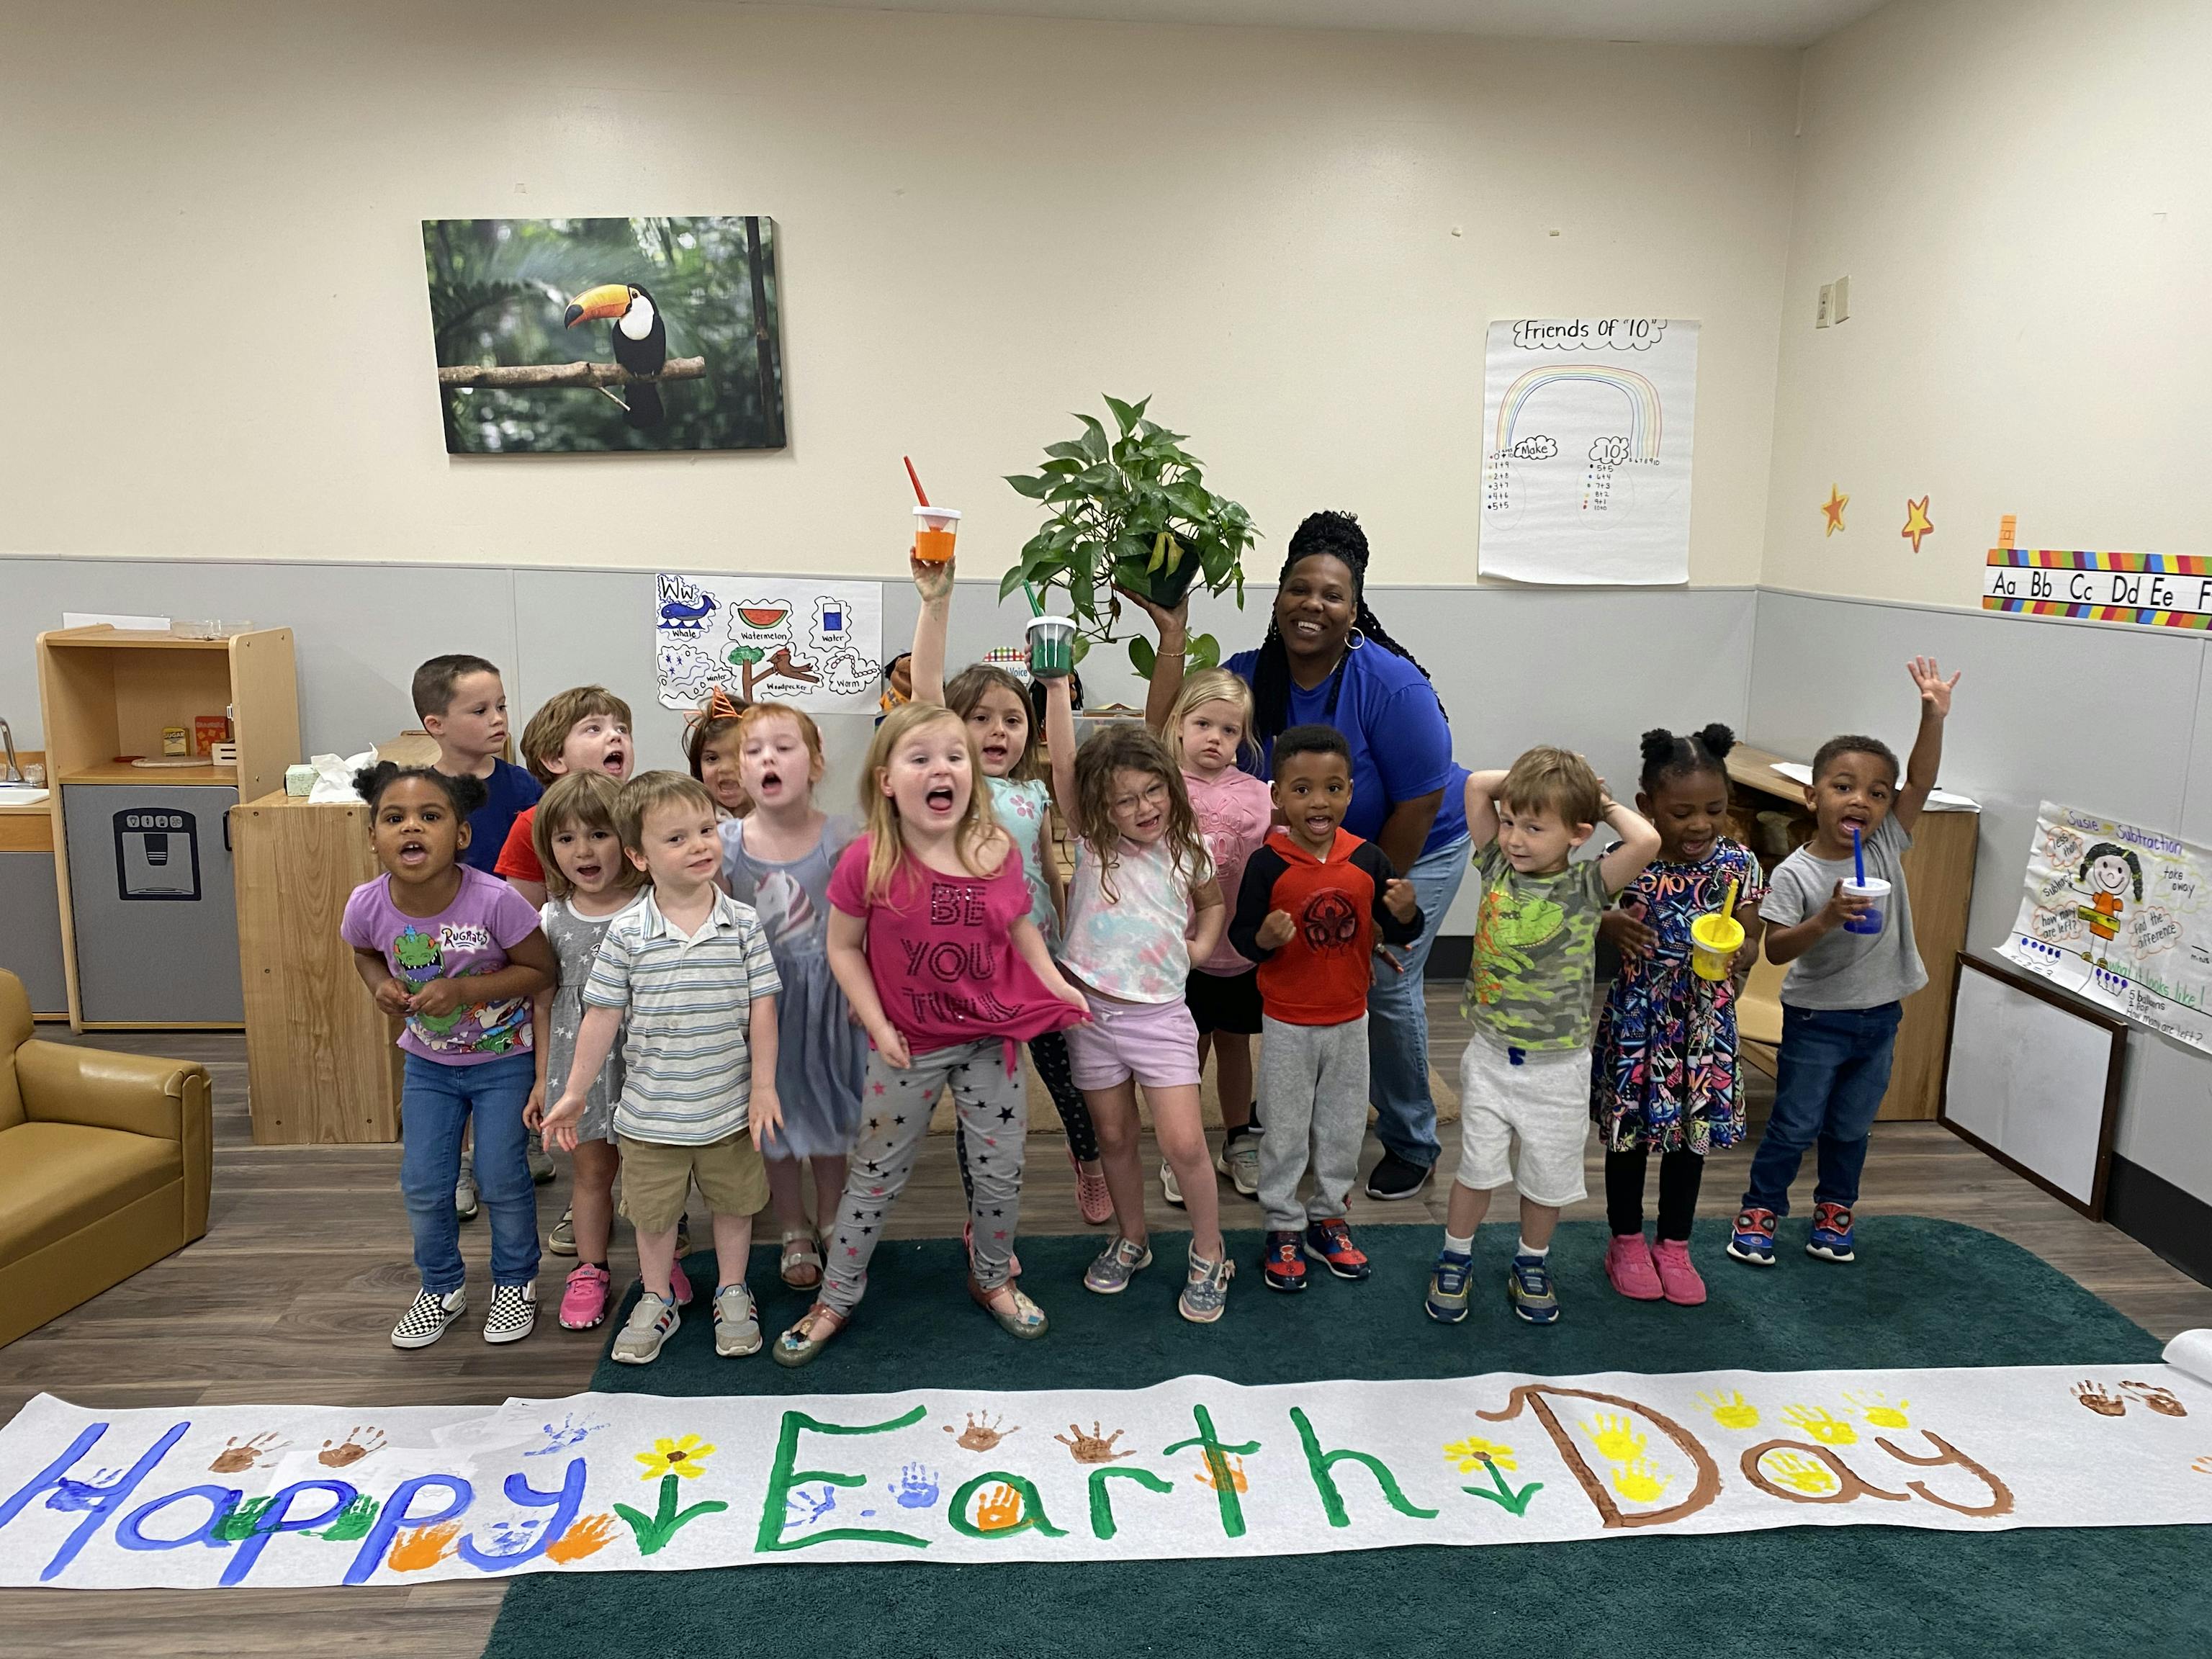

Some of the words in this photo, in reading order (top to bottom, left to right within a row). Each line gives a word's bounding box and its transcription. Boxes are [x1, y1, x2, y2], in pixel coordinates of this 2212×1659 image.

[1525, 319, 1588, 339] Friends
[1598, 319, 1619, 336] Of
[1521, 442, 1548, 454] Make
[1605, 445, 1620, 458] 10
[1993, 570, 2015, 595] Aa
[2031, 571, 2051, 597] Bb
[2070, 573, 2092, 601] Cc
[2112, 575, 2140, 604] Dd
[2151, 577, 2173, 606] Ee
[2198, 580, 2212, 609] F
[672, 628, 696, 638] Whale
[741, 631, 787, 640] Watermelon
[2052, 833, 2069, 850] less
[2067, 811, 2098, 831] Susie
[2116, 824, 2182, 856] Subtraction
[2063, 841, 2077, 857] than
[2164, 866, 2183, 880] take
[2172, 883, 2195, 899] away
[931, 883, 986, 927] BE
[2041, 914, 2057, 927] how
[2150, 912, 2163, 926] the
[2043, 928, 2056, 938] are
[2138, 924, 2177, 949] difference
[901, 938, 995, 983] YOU
[2146, 969, 2170, 996] looks
[2129, 989, 2136, 1000] 5
[0, 1421, 585, 1586] Happy
[755, 1404, 1439, 1553] Earth
[1475, 1385, 2015, 1528] Day
